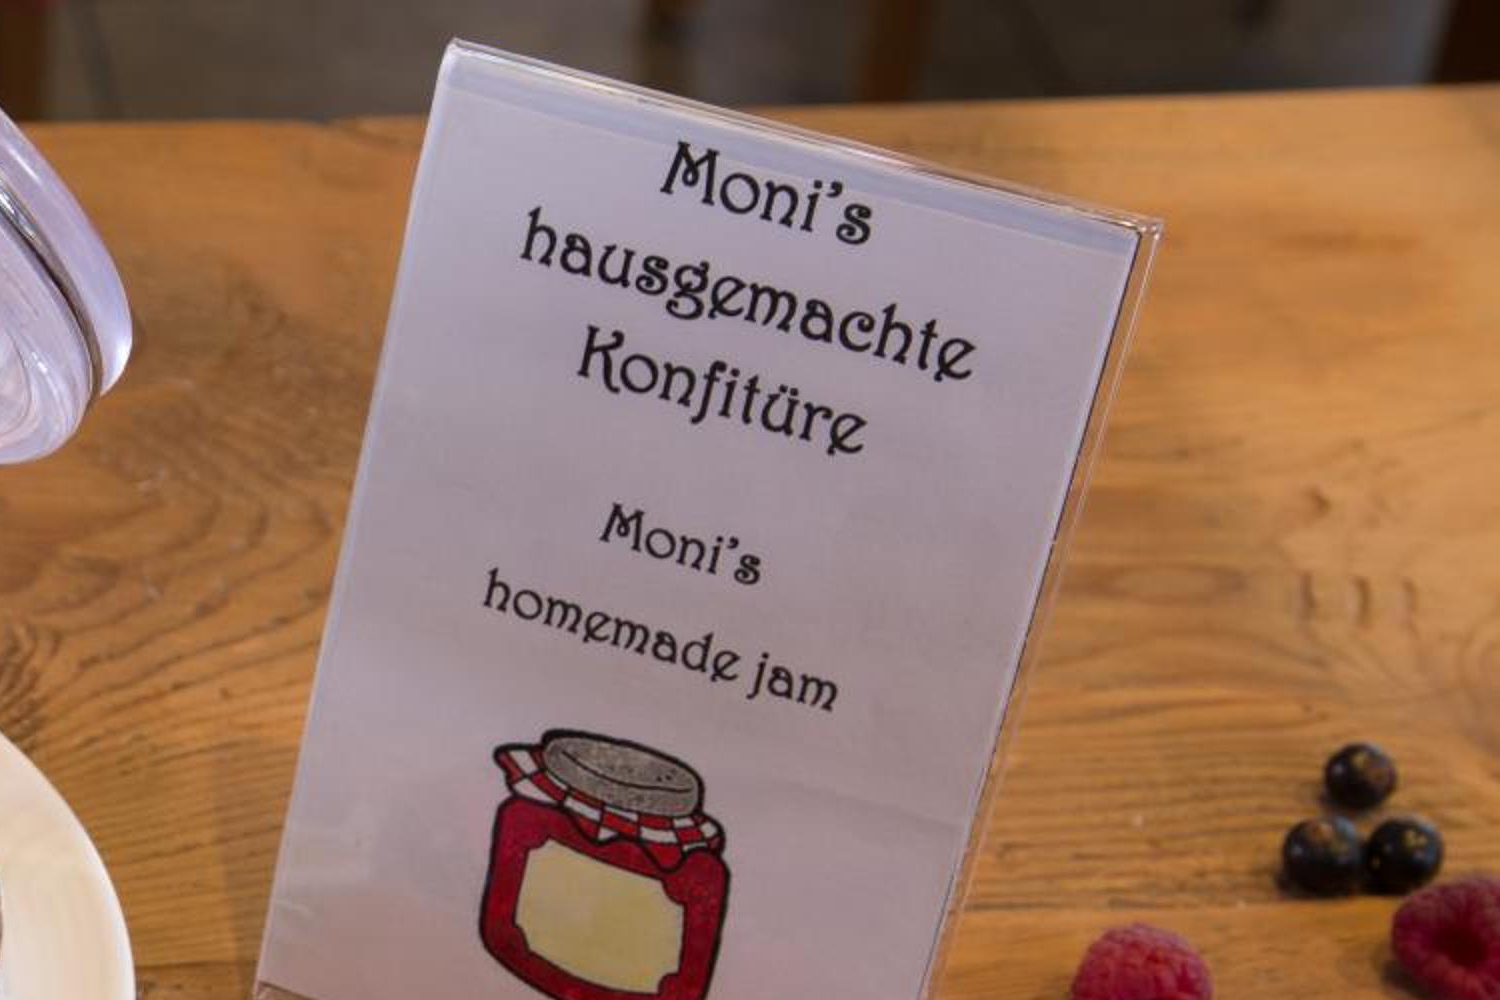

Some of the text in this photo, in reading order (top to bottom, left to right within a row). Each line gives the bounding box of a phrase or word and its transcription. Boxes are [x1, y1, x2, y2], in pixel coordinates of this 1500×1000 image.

[659, 140, 872, 246] Moni's
[520, 206, 977, 383] hausgemachte
[576, 324, 868, 457] Konfitüre
[599, 502, 762, 586] Moni's
[483, 567, 839, 713] homemade jam
